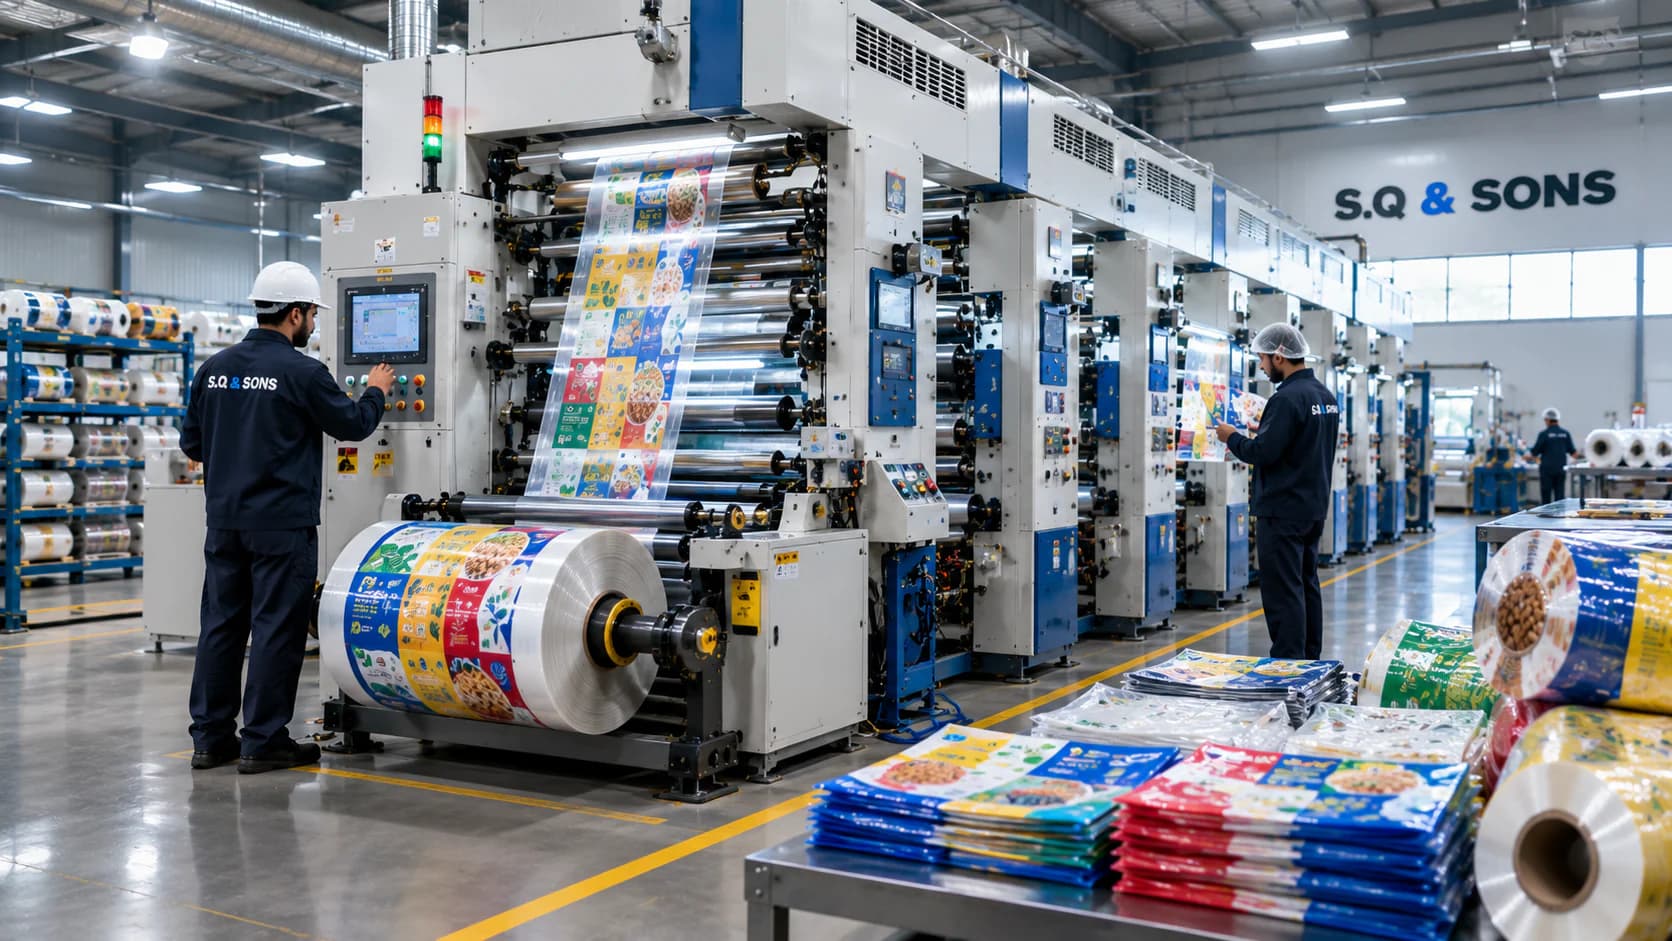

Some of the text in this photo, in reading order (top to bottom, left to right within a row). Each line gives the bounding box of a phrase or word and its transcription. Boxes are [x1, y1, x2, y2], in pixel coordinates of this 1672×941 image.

[1334, 170, 1616, 221] S.Q & SONS
[207, 375, 278, 391] S.Q & SONS
